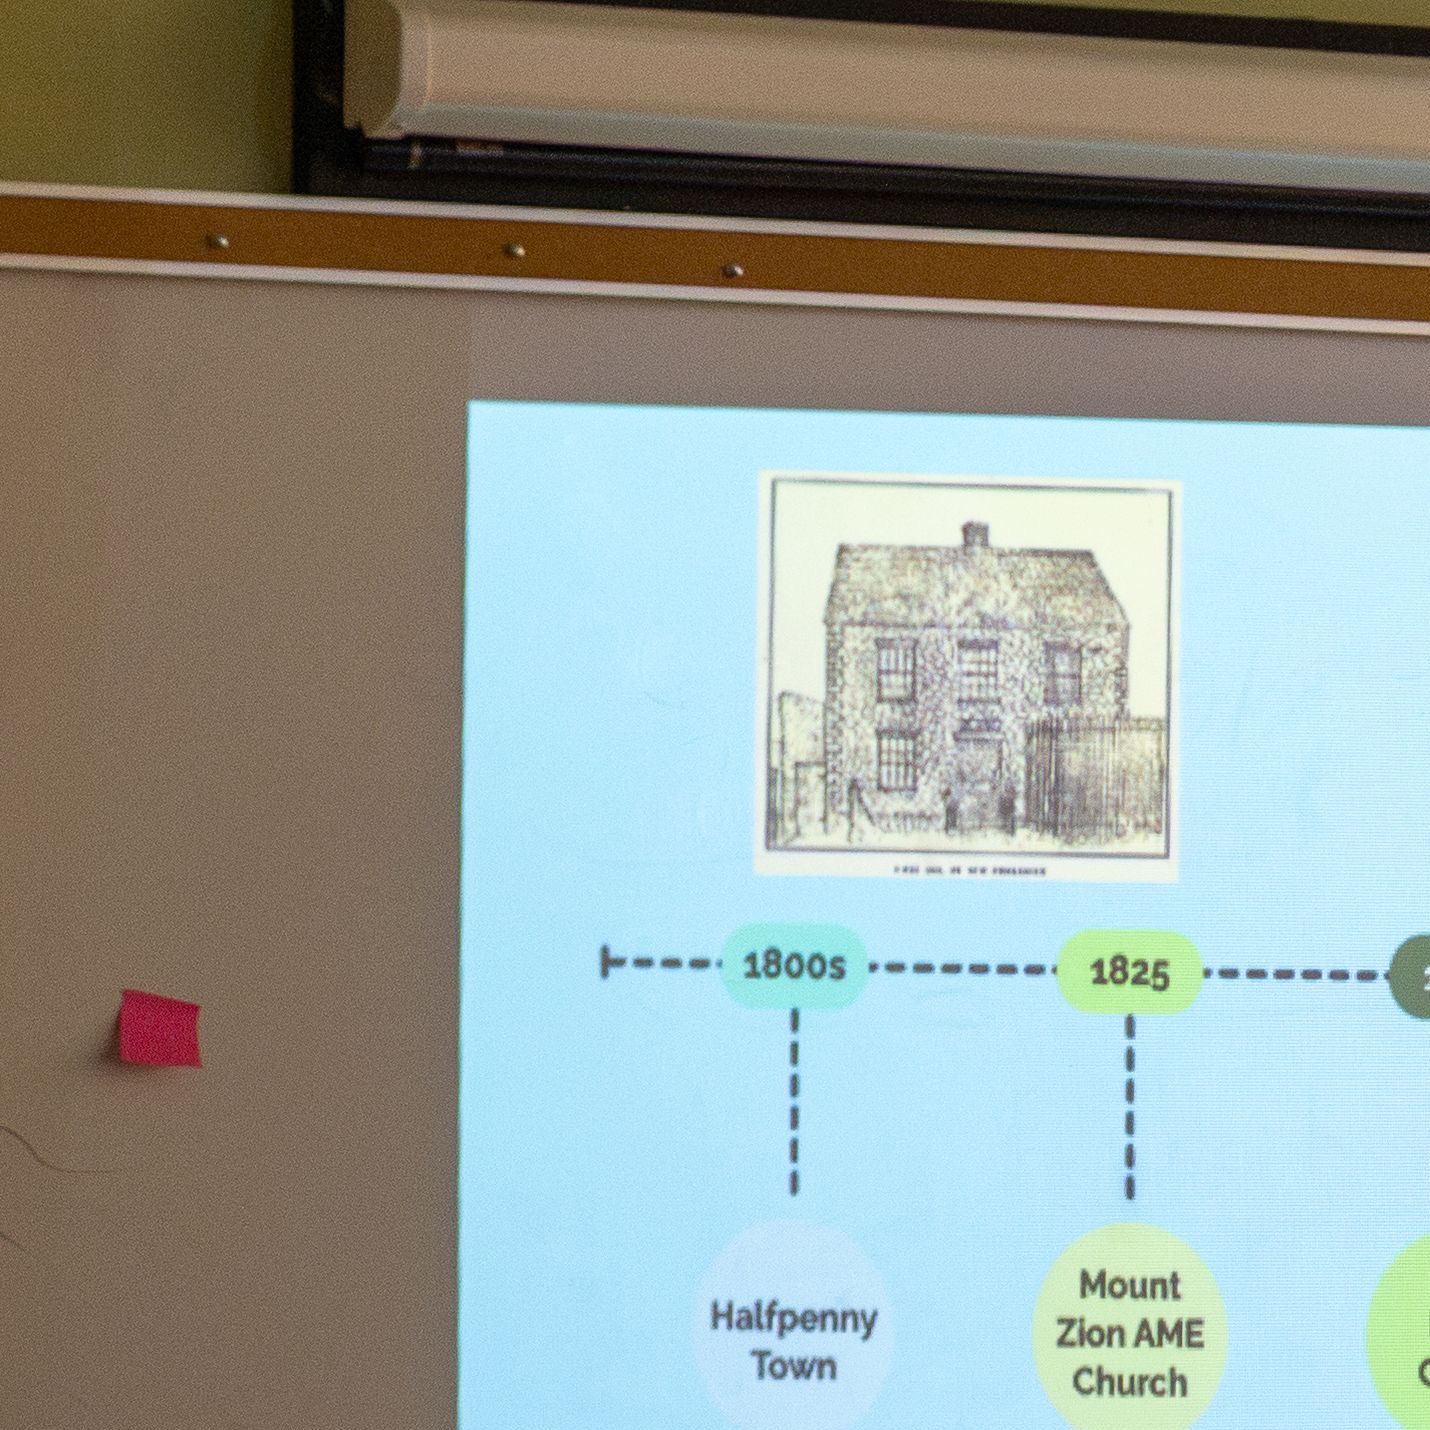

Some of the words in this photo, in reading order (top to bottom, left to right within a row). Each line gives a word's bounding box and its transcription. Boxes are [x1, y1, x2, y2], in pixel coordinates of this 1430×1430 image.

[743, 946, 847, 982] 1800s
[1090, 953, 1171, 993] 1825
[1079, 1268, 1182, 1301] Mount
[710, 1298, 879, 1342] Halfpenny
[1056, 1316, 1127, 1349] Zion
[1132, 1317, 1205, 1350] AME
[749, 1348, 838, 1381] Town
[1072, 1364, 1188, 1398] Church
